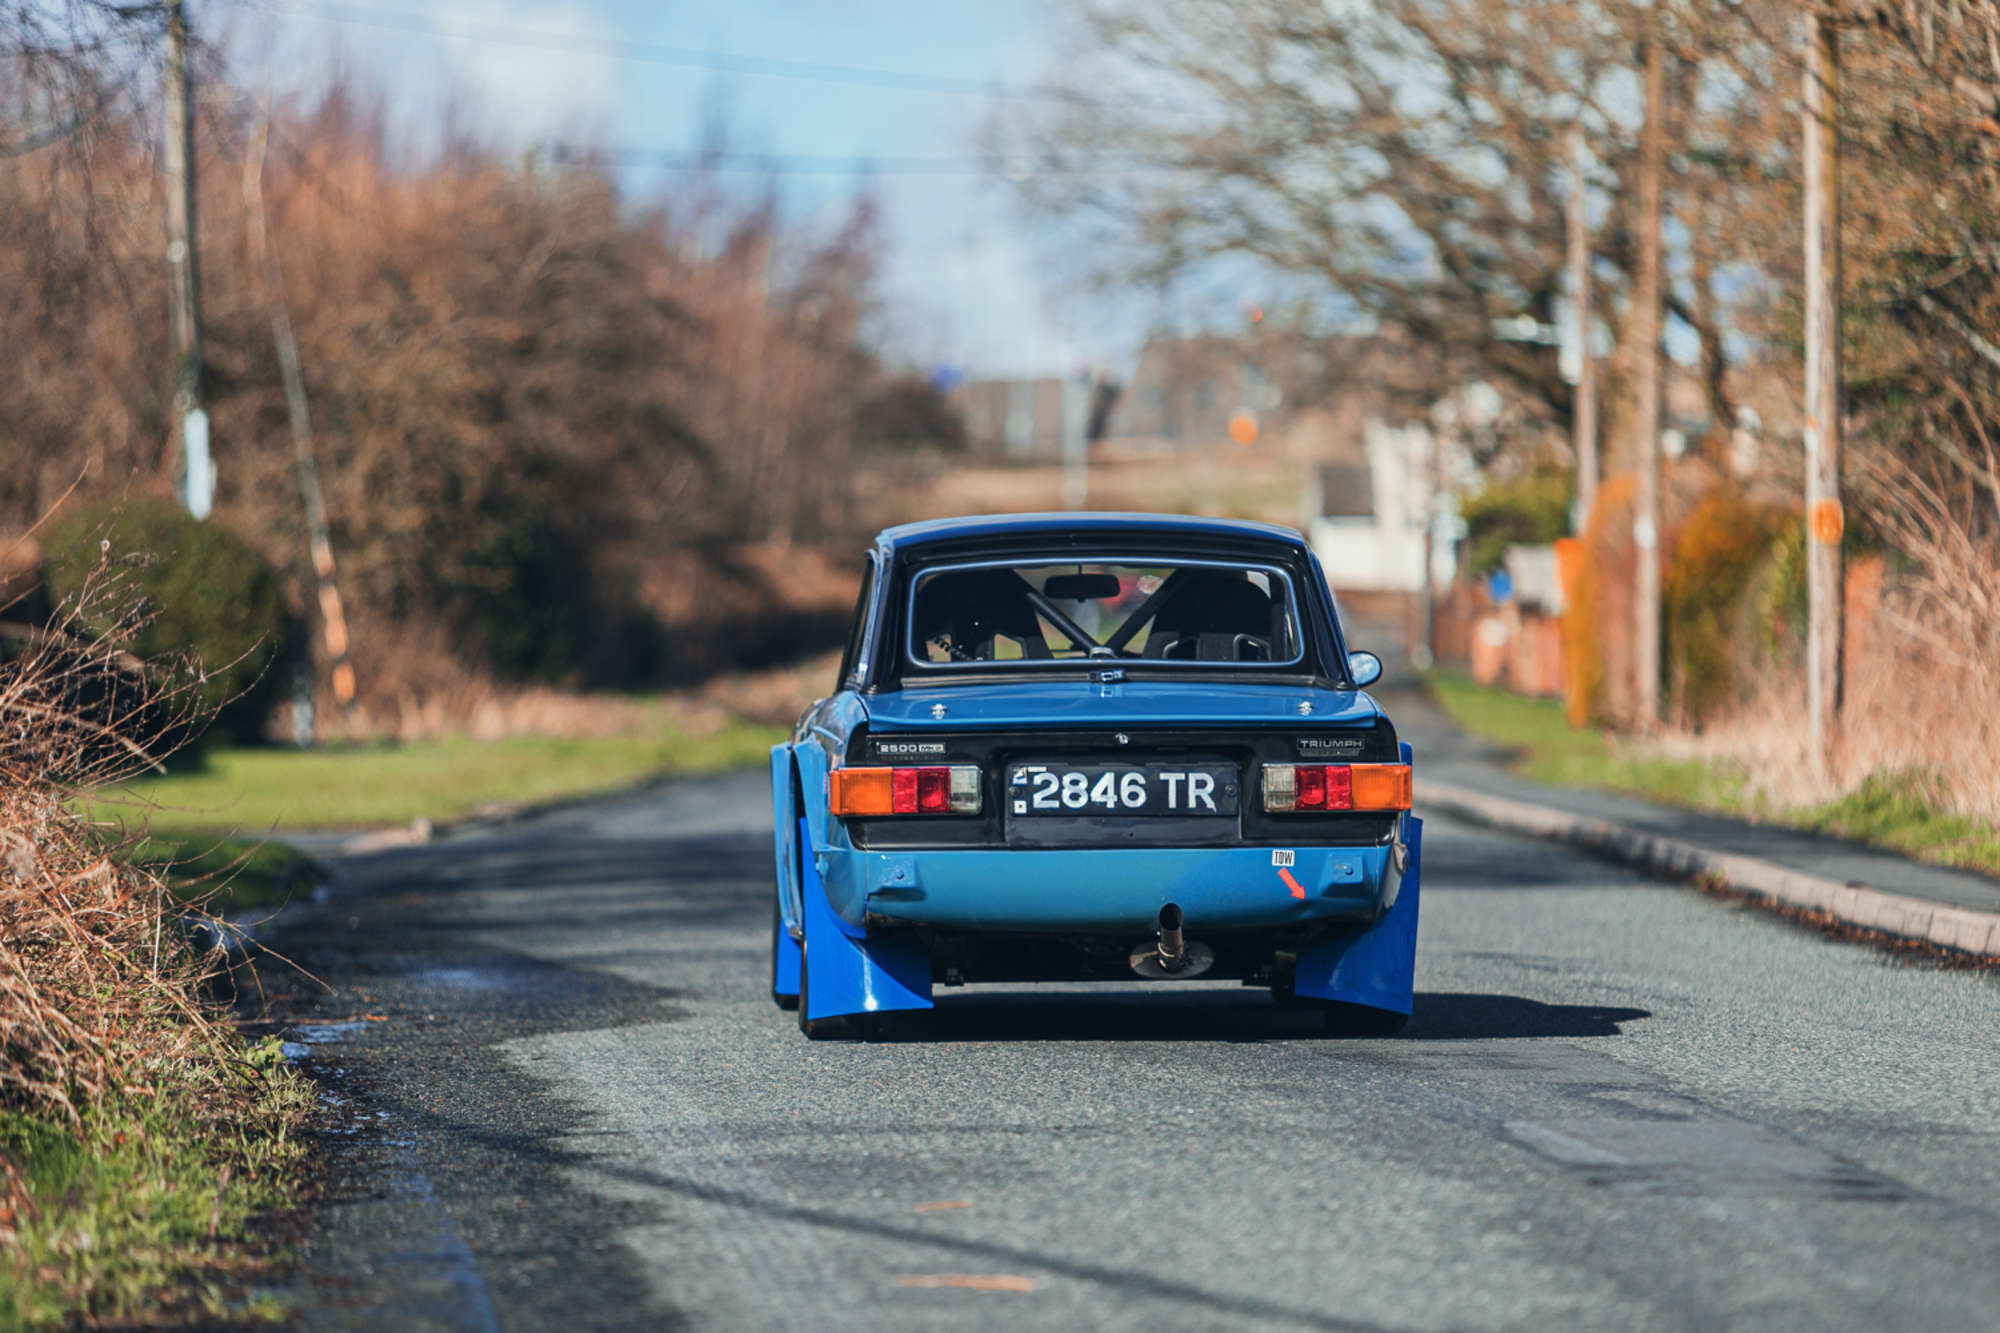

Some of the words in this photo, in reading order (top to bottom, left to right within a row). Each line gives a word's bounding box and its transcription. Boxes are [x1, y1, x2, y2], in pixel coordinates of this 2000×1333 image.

[1300, 740, 1362, 748] TRIUMPH
[1032, 772, 1147, 809] 2846
[1159, 772, 1217, 812] TR
[1274, 851, 1293, 865] TOW
